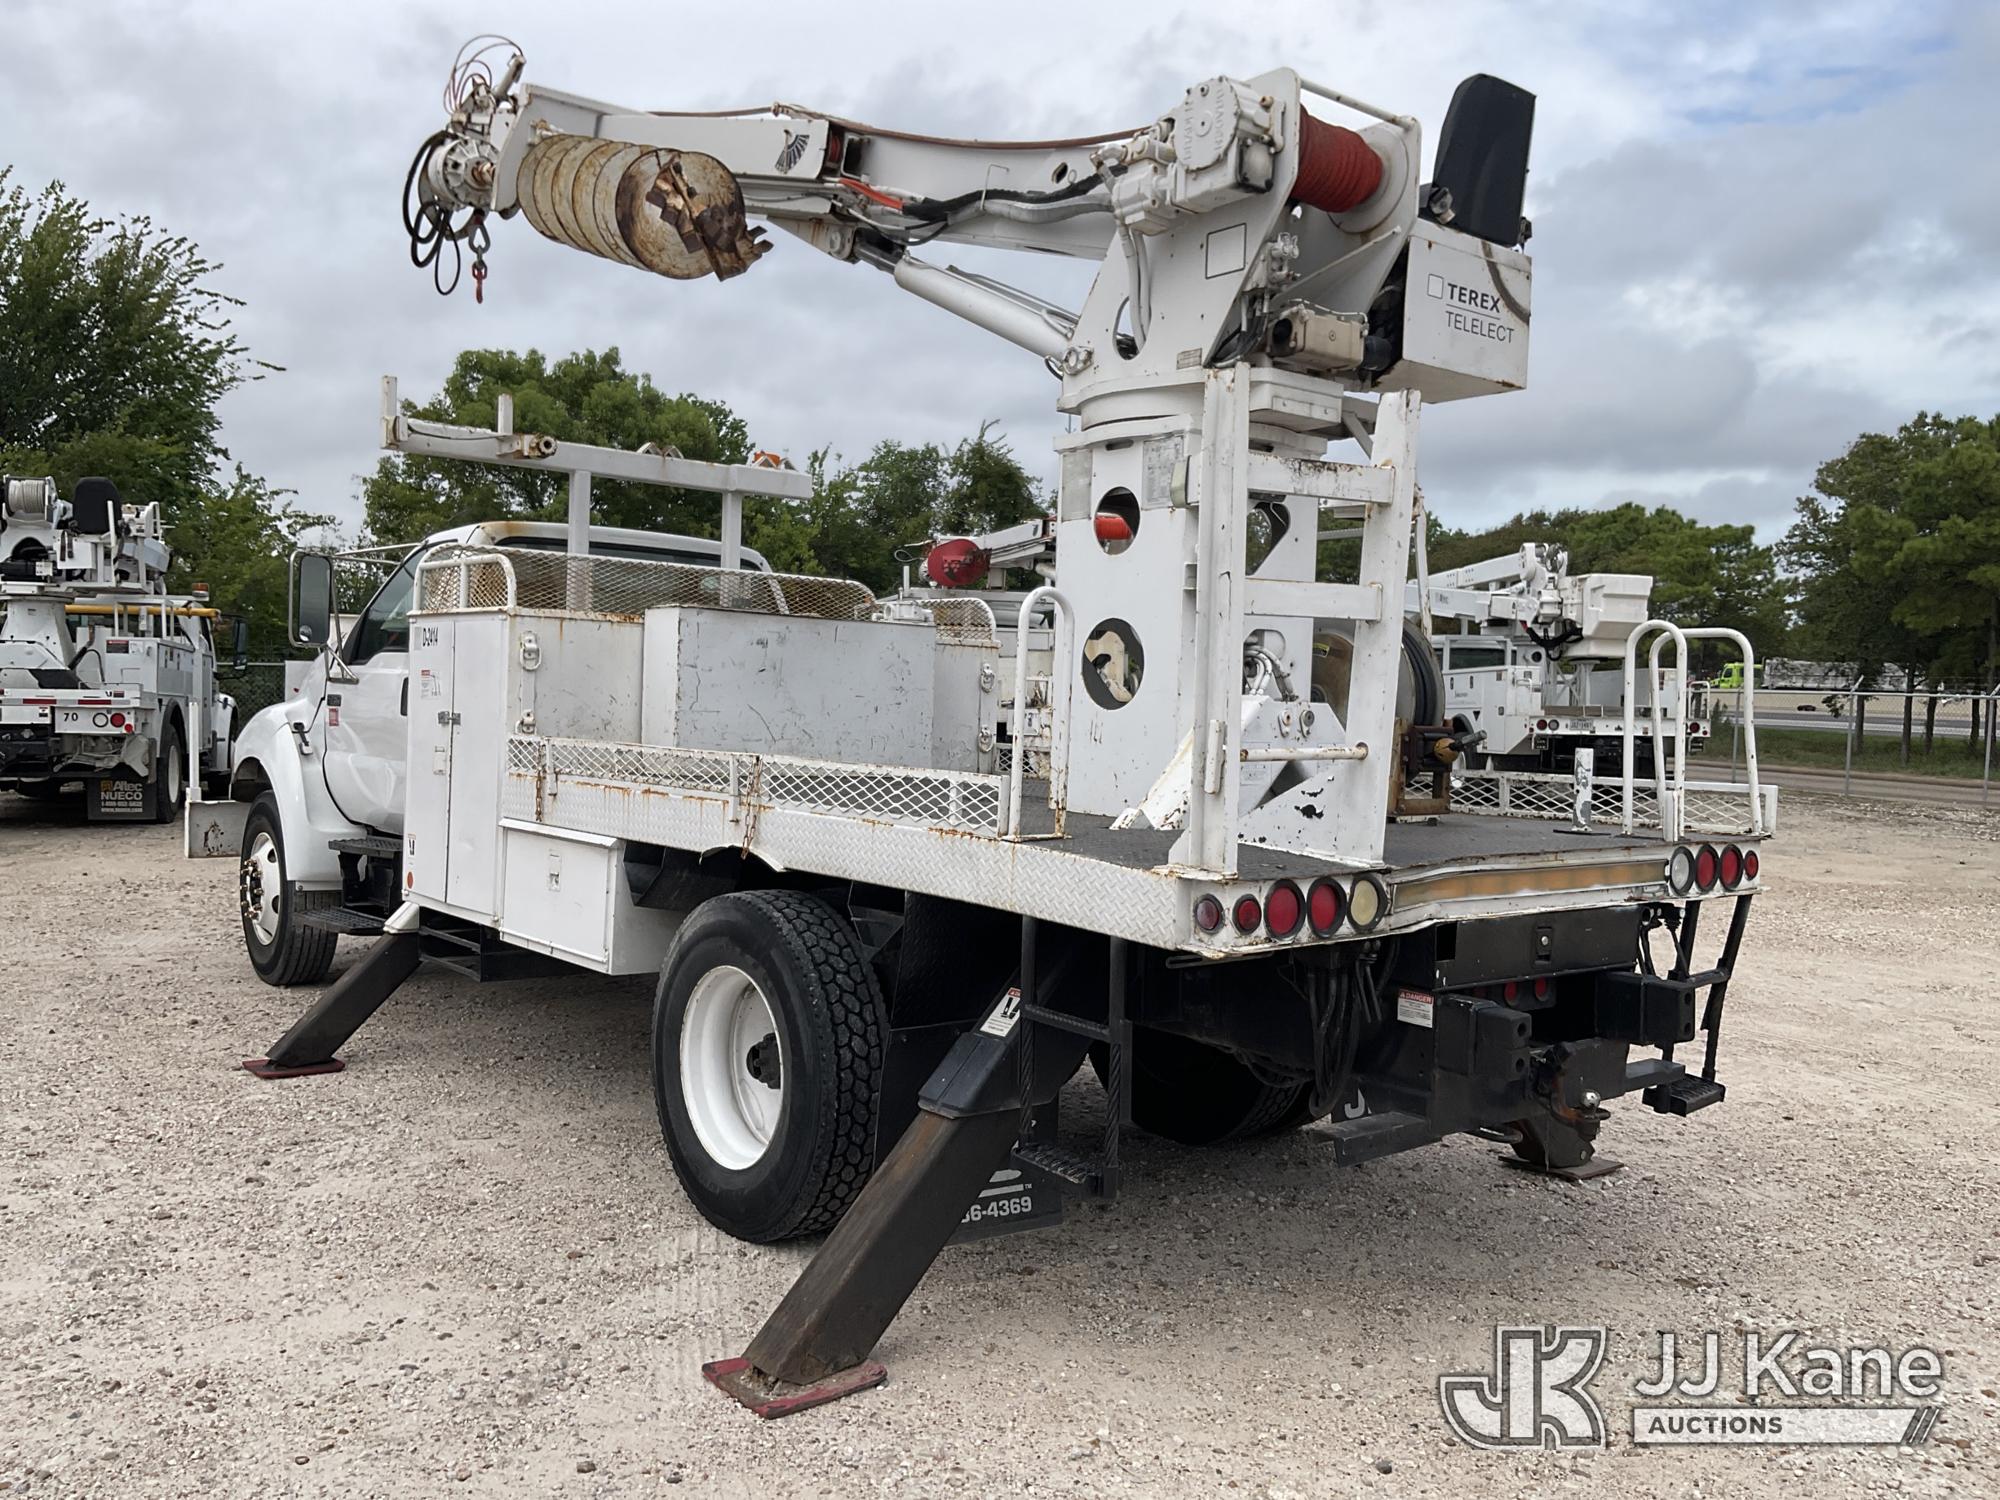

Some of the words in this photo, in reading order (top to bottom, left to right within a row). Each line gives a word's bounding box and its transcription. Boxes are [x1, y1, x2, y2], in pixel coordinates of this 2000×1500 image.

[1447, 282, 1501, 313] TEREX
[1445, 310, 1515, 344] TELELECT
[63, 712, 79, 722] 70
[113, 780, 143, 792] Altec
[100, 791, 143, 801] NUECO
[1405, 992, 1432, 1005] DANGER
